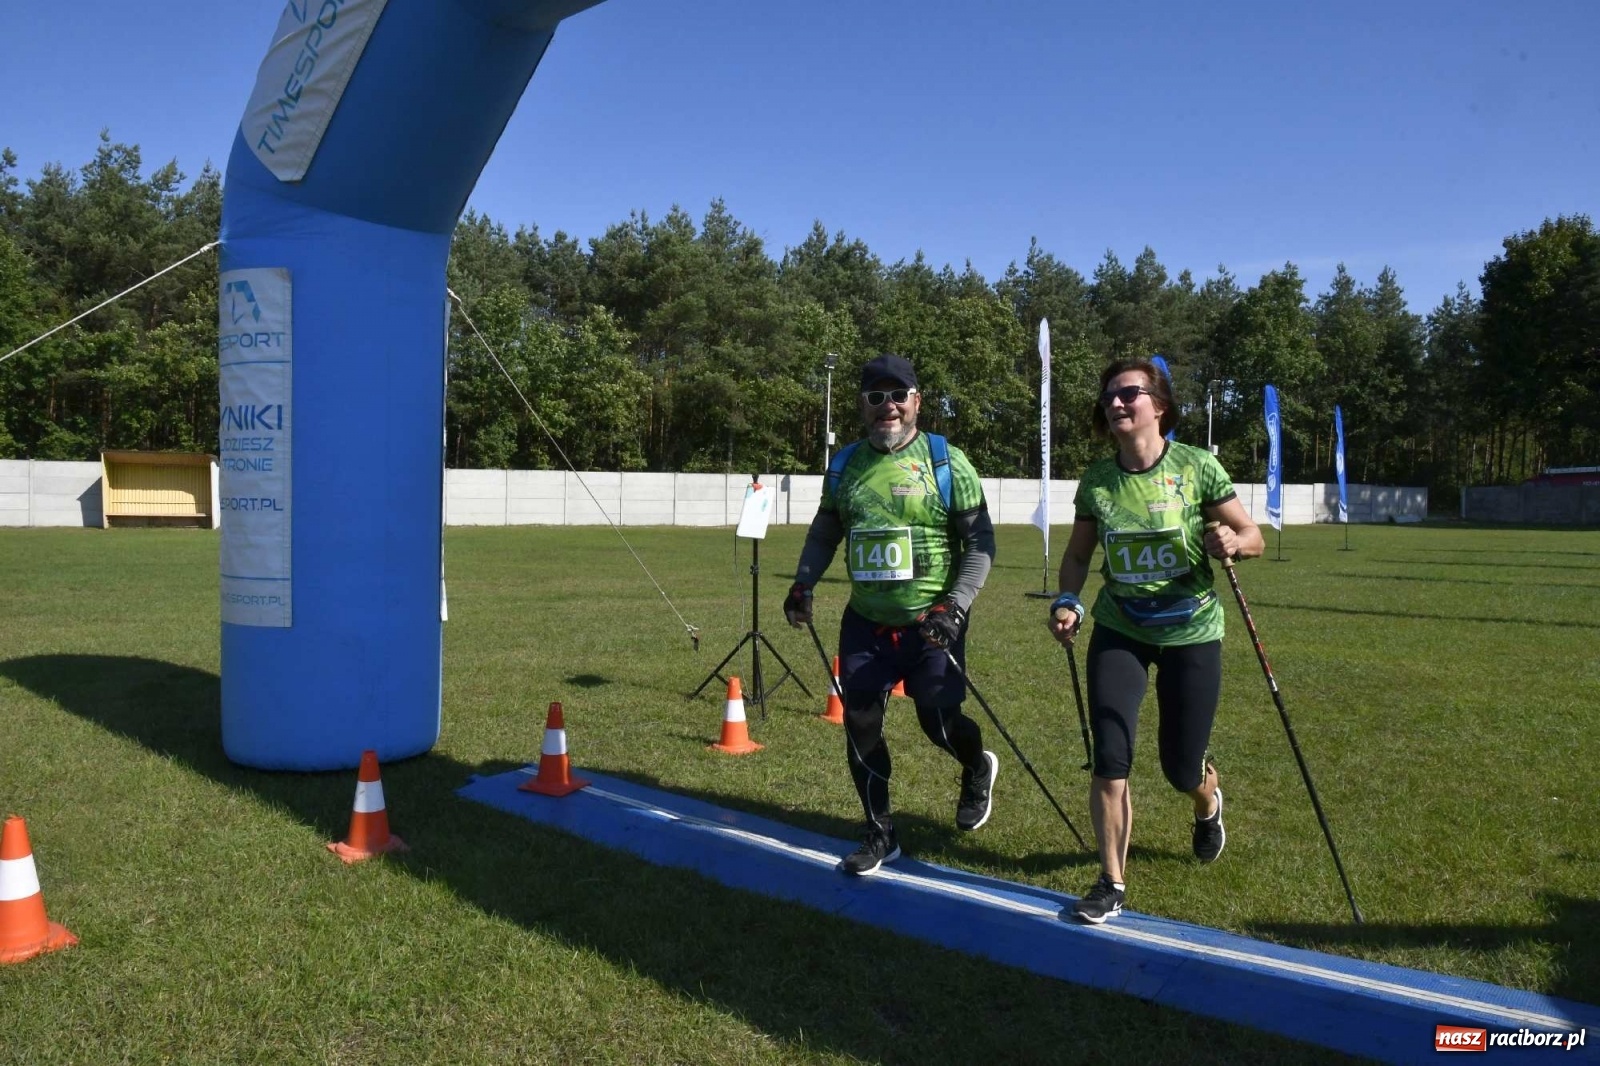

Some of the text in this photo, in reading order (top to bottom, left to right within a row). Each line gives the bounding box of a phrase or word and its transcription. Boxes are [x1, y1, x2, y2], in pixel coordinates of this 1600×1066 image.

[257, 0, 345, 155] TIMESPO
[855, 542, 903, 568] 140
[1116, 543, 1178, 571] 146
